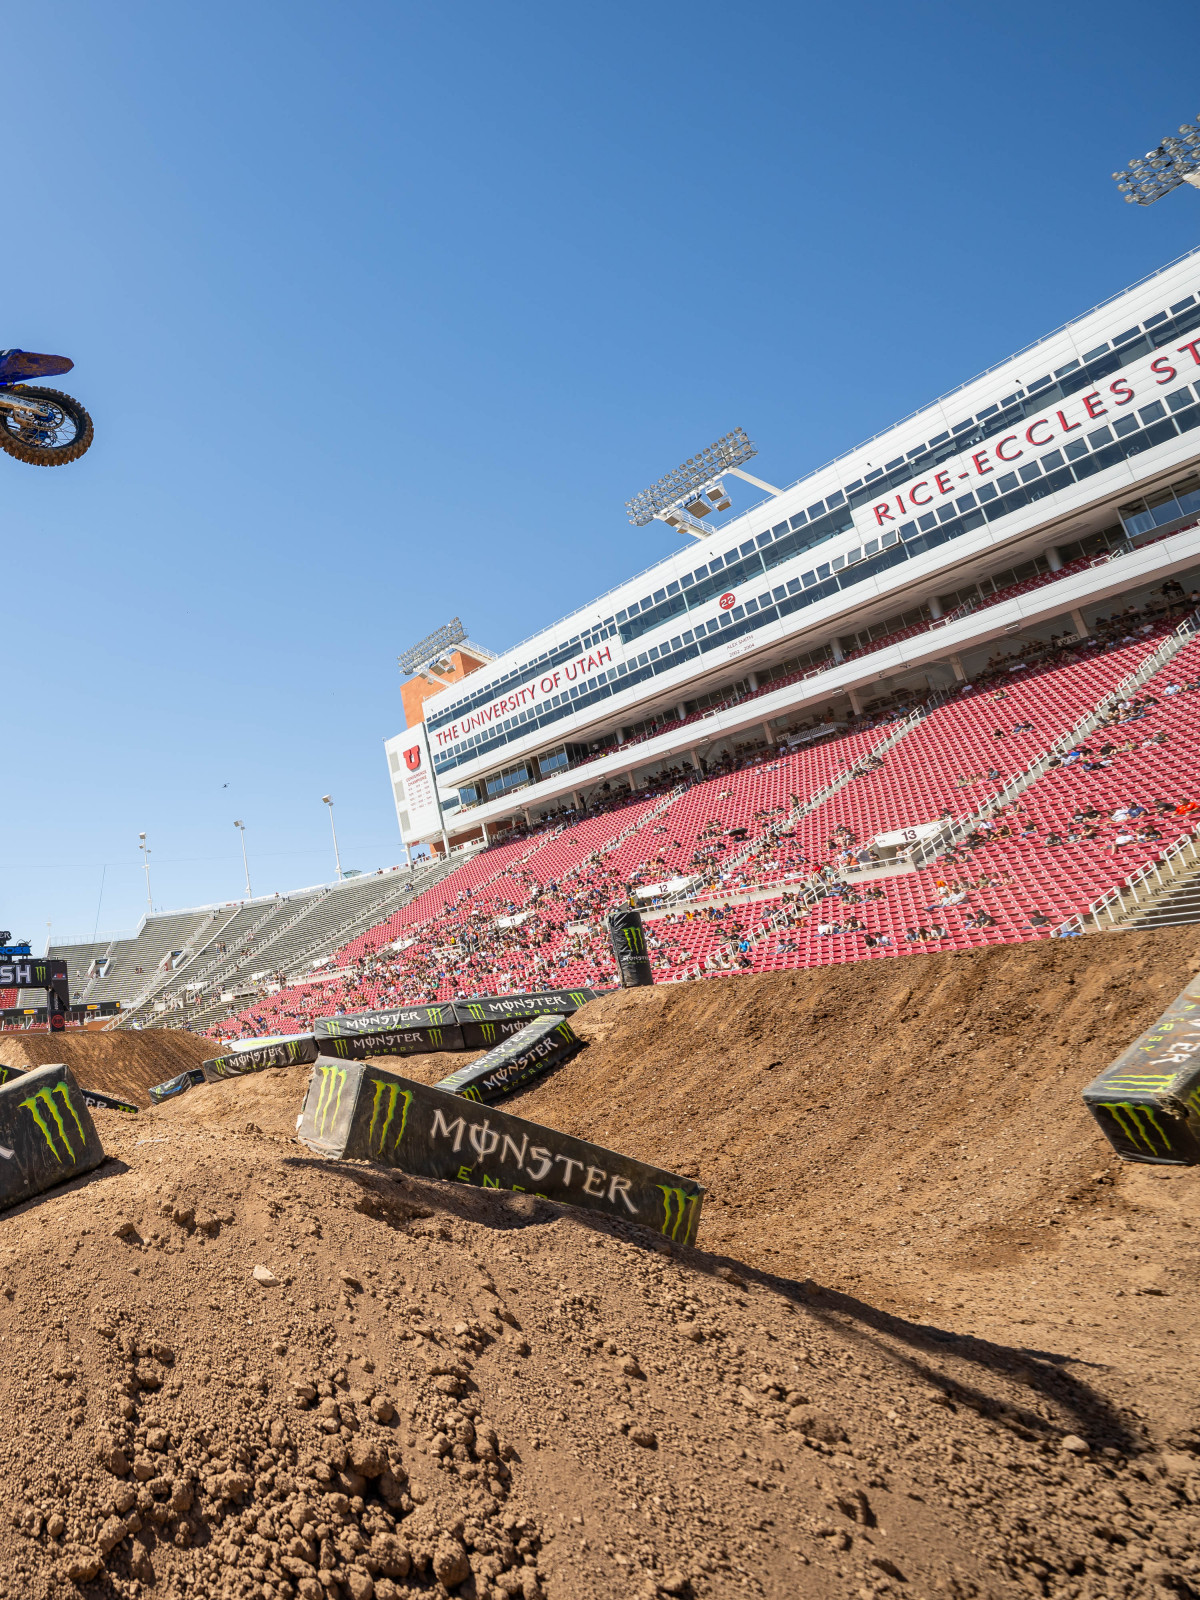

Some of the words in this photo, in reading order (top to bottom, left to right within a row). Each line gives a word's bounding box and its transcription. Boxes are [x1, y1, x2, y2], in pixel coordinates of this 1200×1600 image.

[873, 378, 1135, 526] RICE-ECCLES
[721, 595, 735, 607] 22
[727, 642, 738, 650] ALEX
[739, 635, 754, 644] SMITH
[436, 725, 459, 746] THE
[461, 684, 536, 734] UNIVERSITY
[540, 672, 560, 694] OF
[565, 646, 612, 681] UTAH
[901, 829, 917, 841] 13
[658, 884, 668, 893] 12
[489, 996, 567, 1012] MONSTER
[506, 1007, 559, 1018] ENERGY
[346, 1011, 422, 1029] MONSTER
[353, 1032, 424, 1049] MONSTER
[229, 1046, 284, 1067] MONSTER
[483, 1037, 559, 1090] MONSTER
[502, 1057, 550, 1092] ENERGY
[430, 1108, 639, 1214] MONSTER
